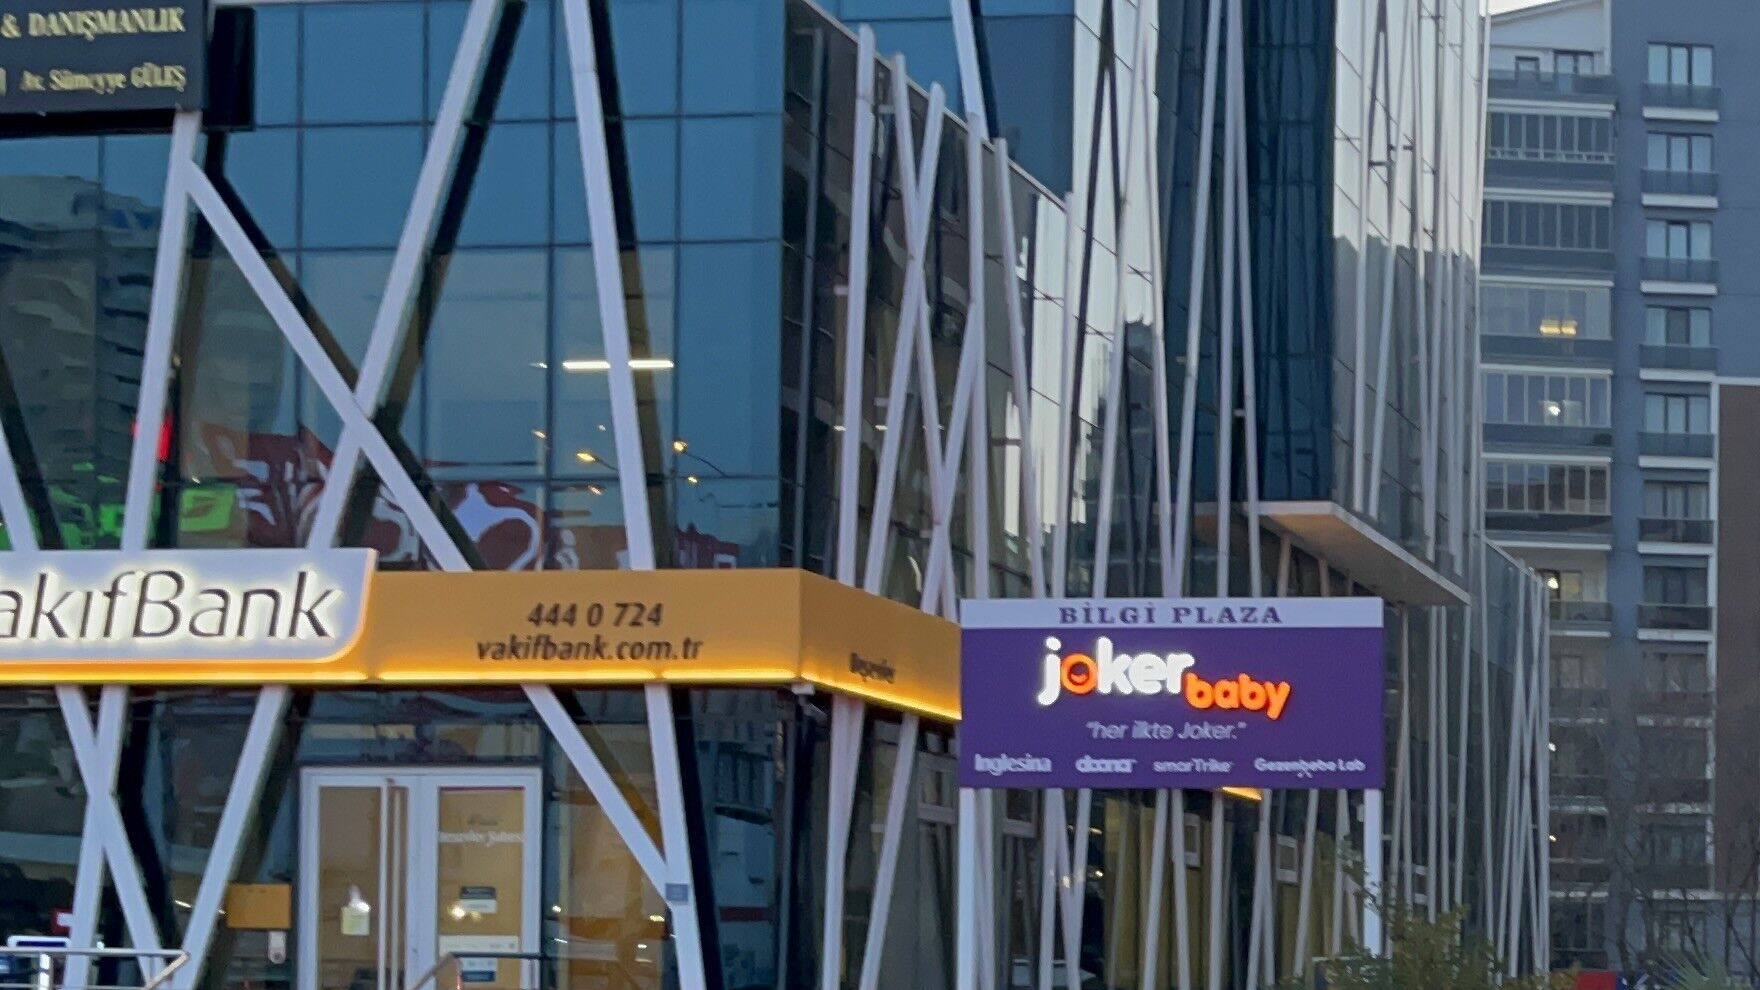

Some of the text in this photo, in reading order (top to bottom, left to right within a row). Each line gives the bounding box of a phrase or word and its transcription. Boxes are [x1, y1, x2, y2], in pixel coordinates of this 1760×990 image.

[0, 7, 186, 41] & DANIŞMANLIK
[527, 602, 664, 627] 444 0 724
[1058, 602, 1284, 625] BİLGİ PLAZA
[476, 634, 704, 660] vakifbank.com.tr
[1037, 636, 1292, 721] joker baby
